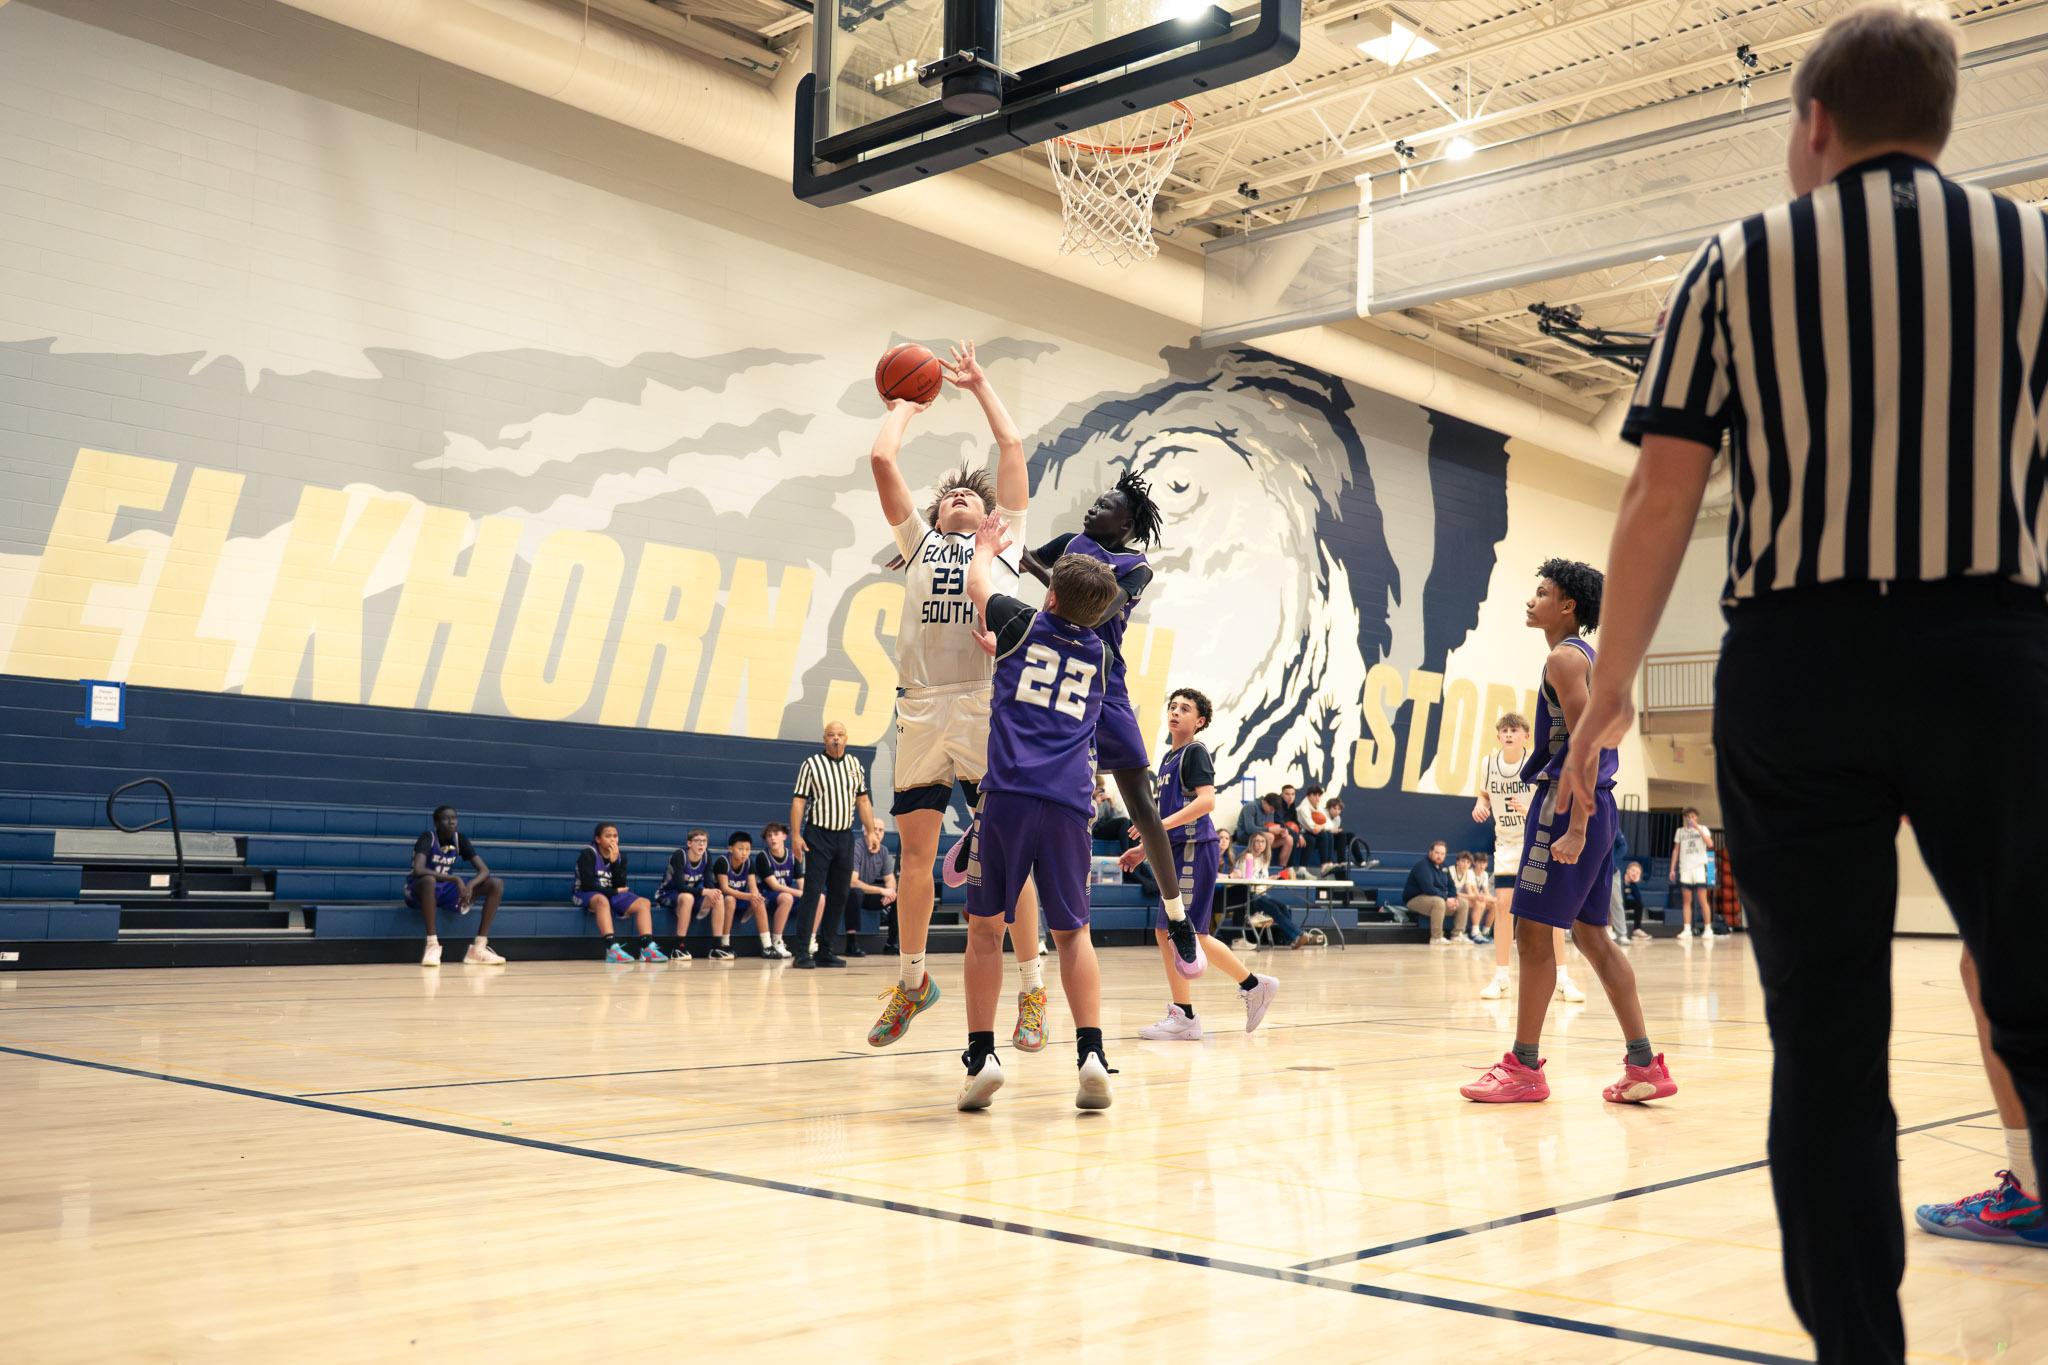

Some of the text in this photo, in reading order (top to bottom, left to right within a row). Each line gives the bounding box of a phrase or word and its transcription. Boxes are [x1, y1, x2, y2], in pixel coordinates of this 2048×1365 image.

[922, 543, 975, 565] ELKHR
[5, 447, 815, 740] ELKHORN
[932, 567, 964, 595] 23
[921, 600, 974, 624] SOUTH
[1015, 642, 1097, 722] 22
[1353, 663, 1540, 798] STOR
[1491, 781, 1531, 793] ELKHORN
